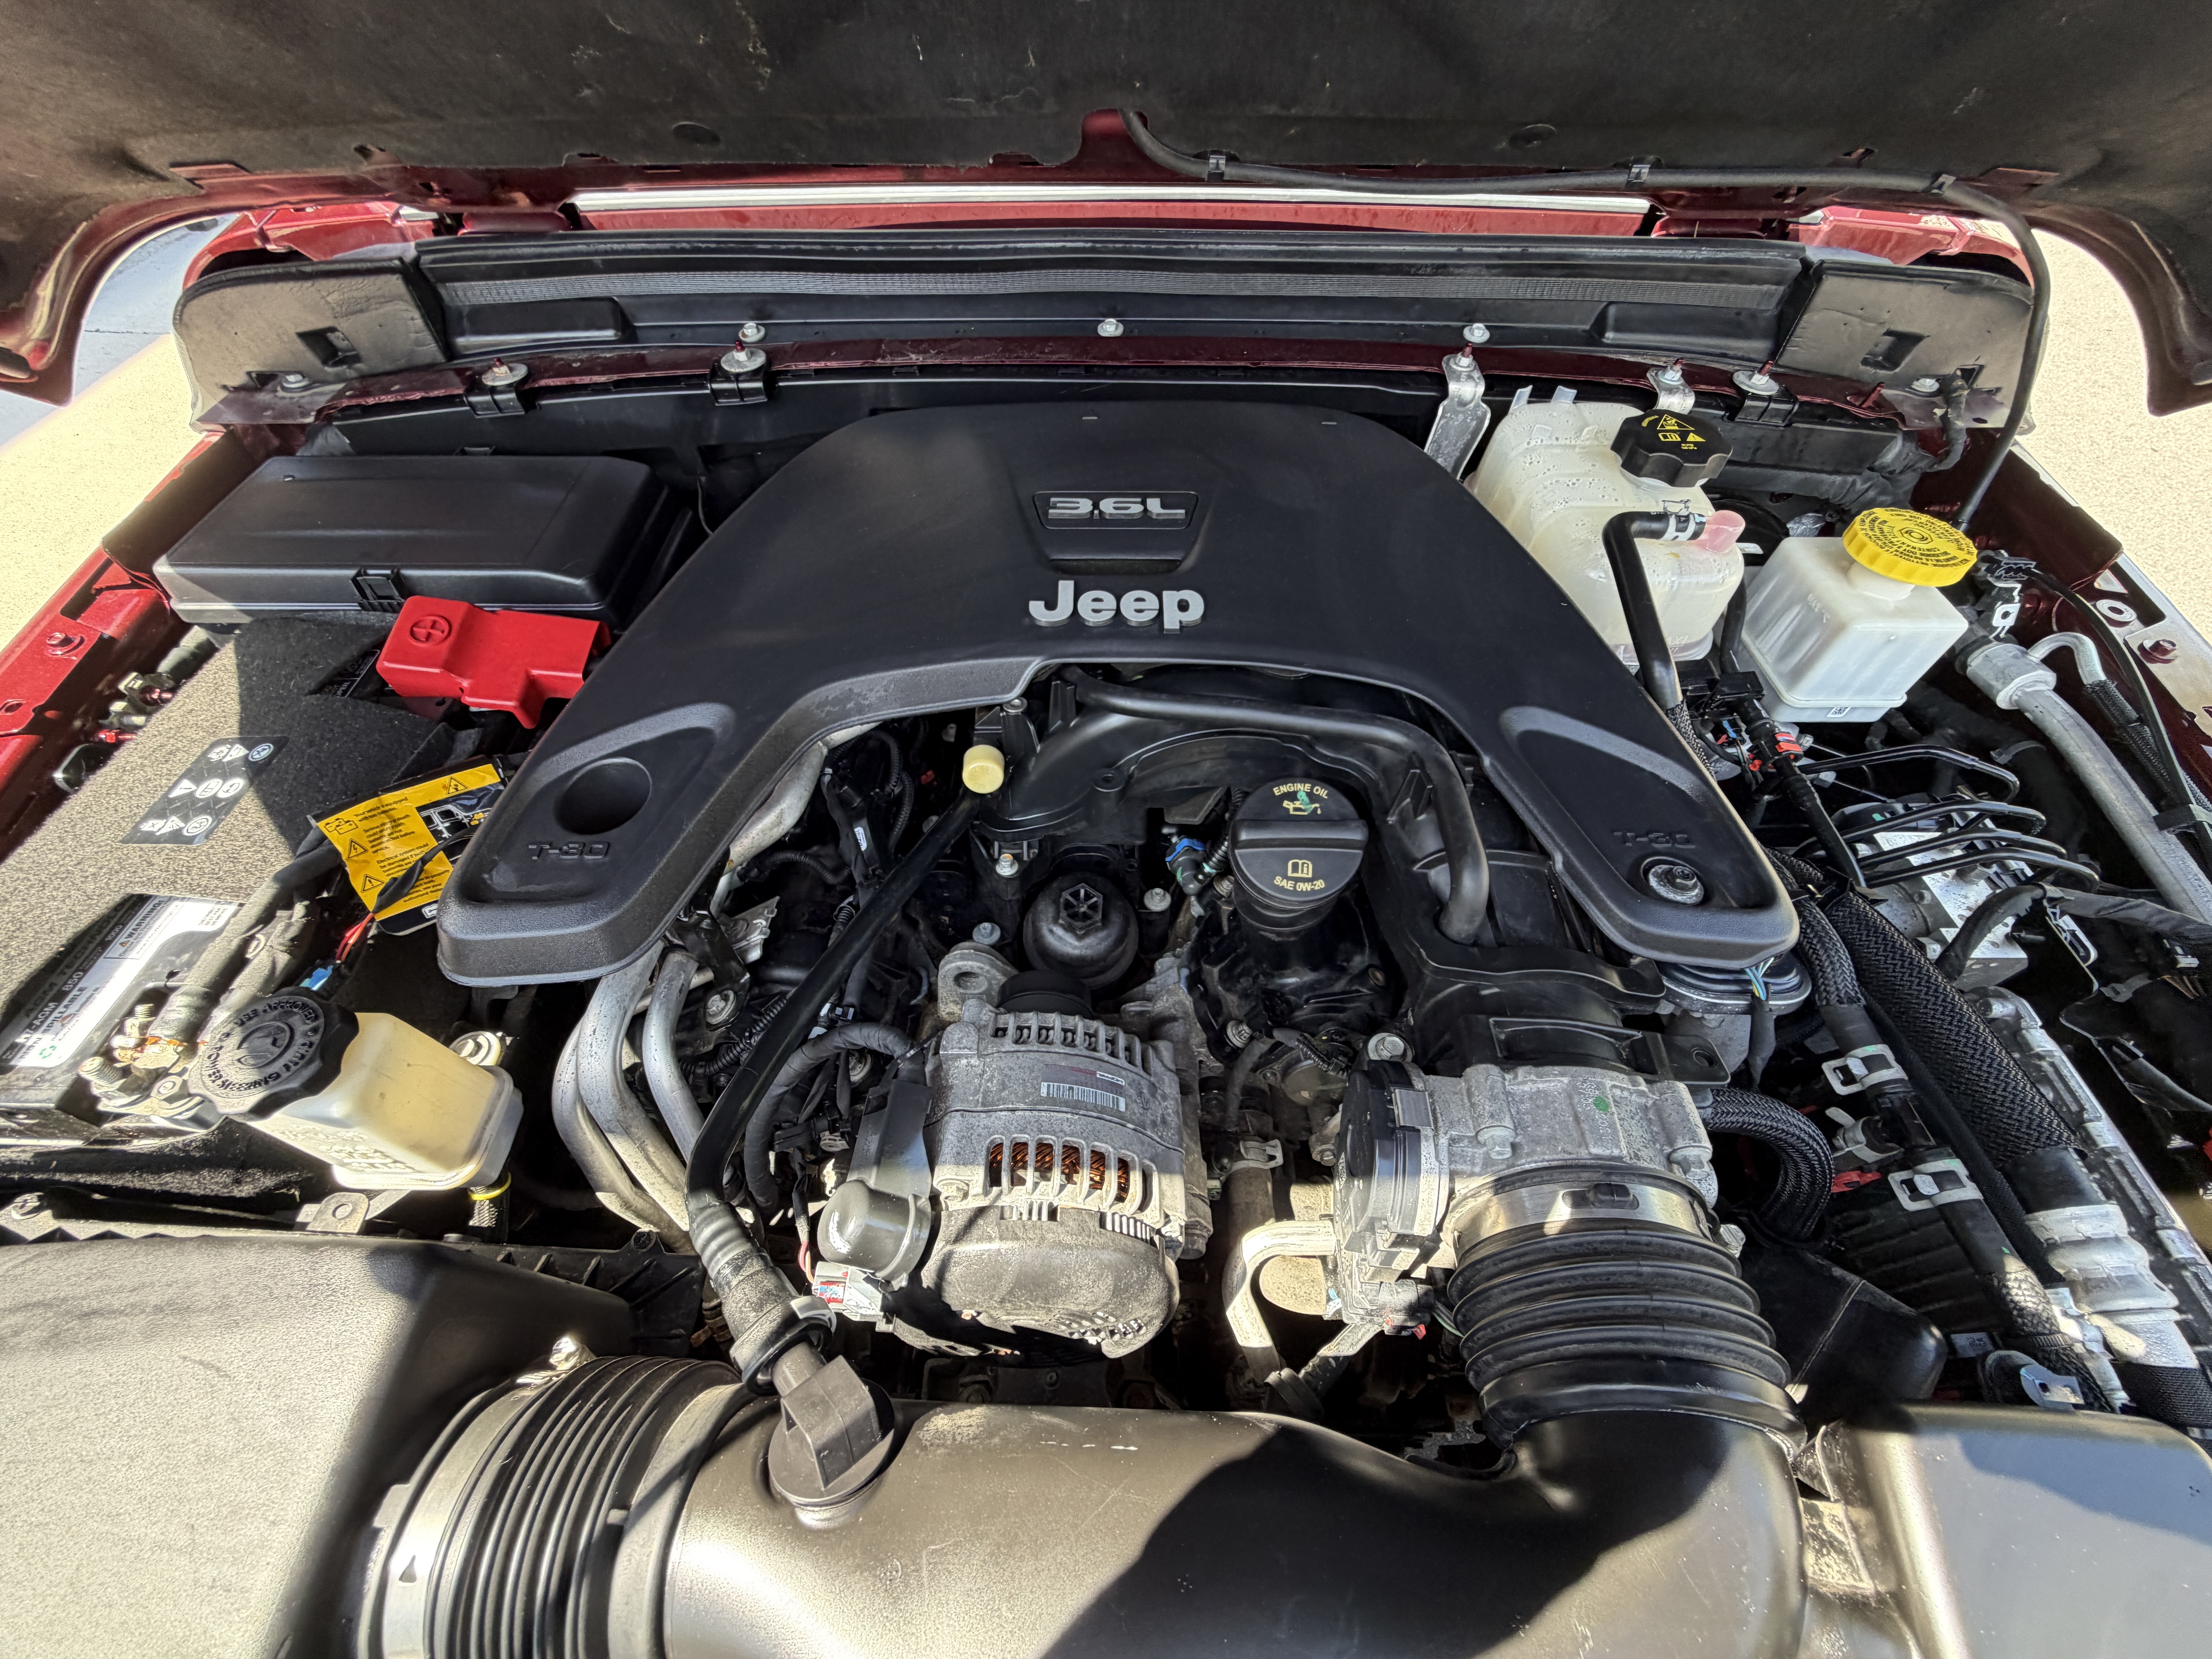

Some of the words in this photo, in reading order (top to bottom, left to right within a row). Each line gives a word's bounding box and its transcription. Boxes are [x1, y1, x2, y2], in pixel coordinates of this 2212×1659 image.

[1048, 497, 1186, 519] 3.6L
[1029, 580, 1205, 634] Jeep
[1273, 783, 1312, 796] ENGINE
[1313, 786, 1329, 799] OIL
[1613, 831, 1696, 849] T-30
[527, 842, 611, 860] T-30
[1274, 876, 1295, 890] SAE
[1296, 879, 1325, 891] 0W-20
[124, 900, 166, 938] WARNING:
[61, 972, 84, 991] 850
[234, 1009, 261, 1027] USE
[262, 1000, 319, 1024] APPROVED
